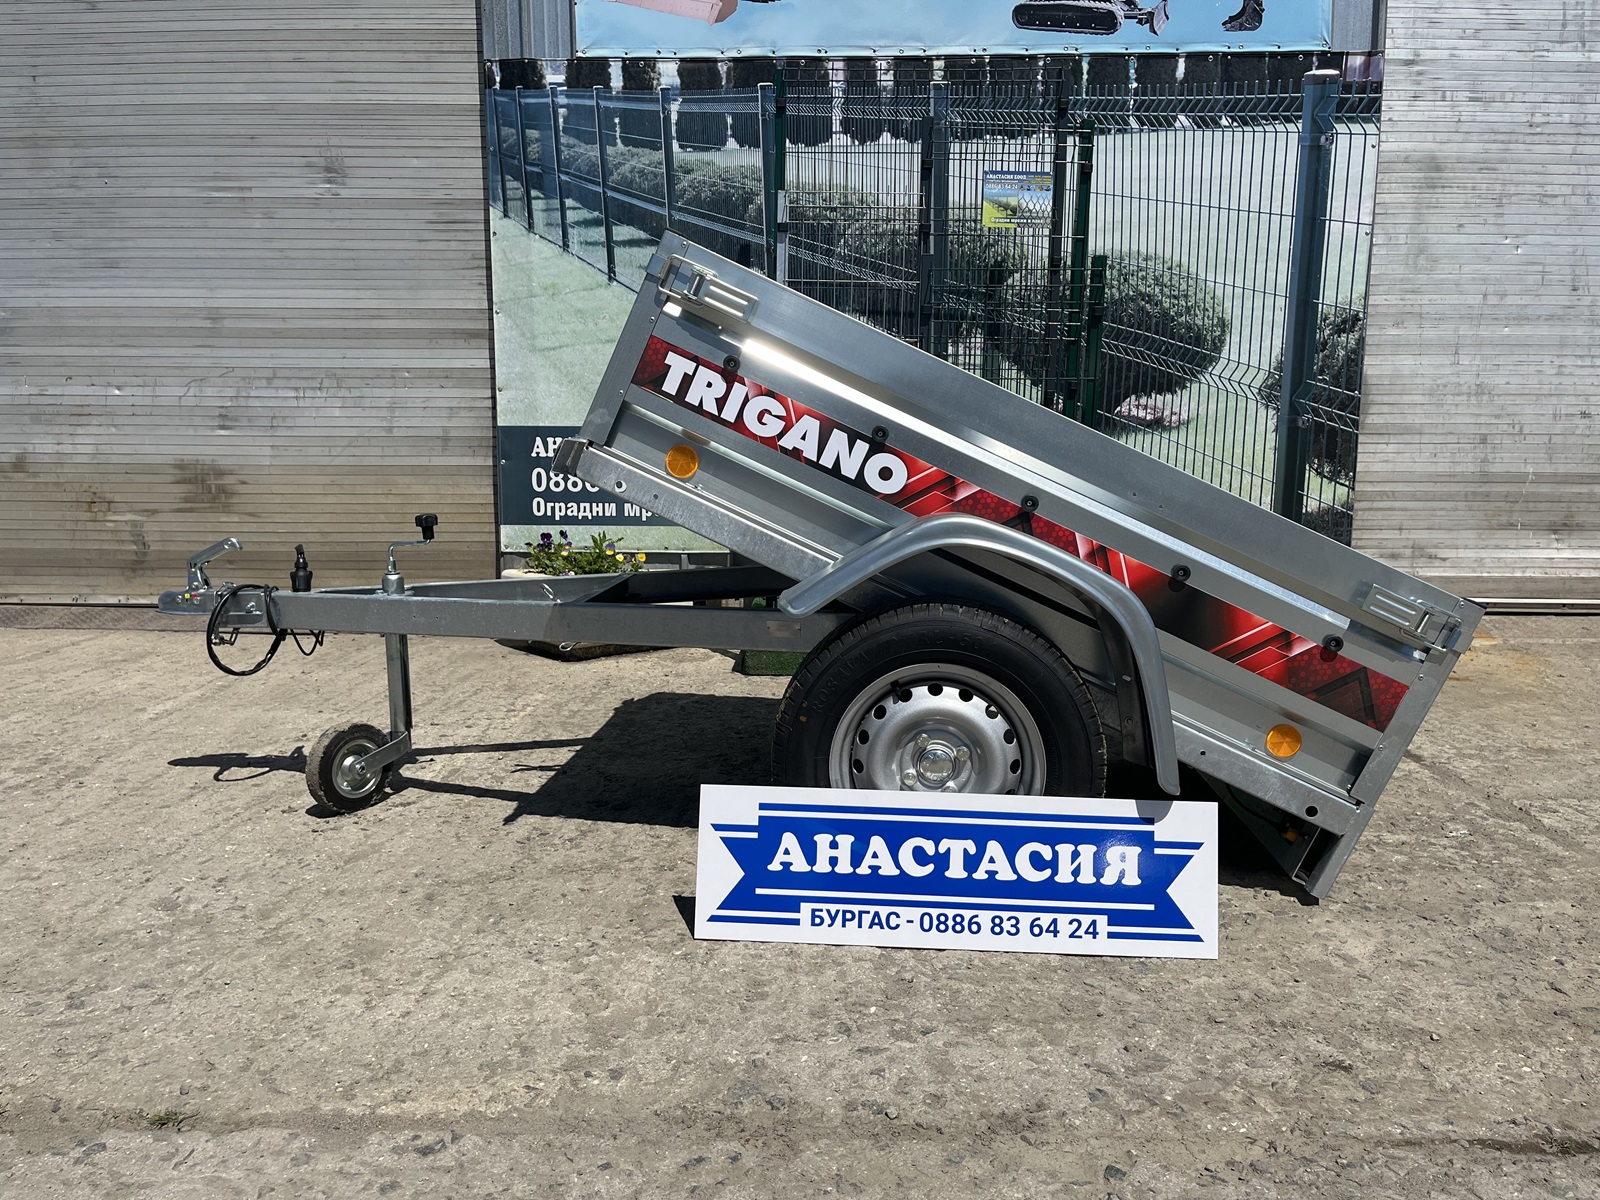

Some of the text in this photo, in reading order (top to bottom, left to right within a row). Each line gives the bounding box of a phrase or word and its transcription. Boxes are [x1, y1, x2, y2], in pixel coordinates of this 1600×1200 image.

[661, 350, 908, 494] TRIGANO
[532, 498, 617, 520] Оградни
[767, 831, 1142, 885] АНАСТАСИЯ
[810, 908, 901, 930] БУРГАС
[919, 912, 982, 935] 0886
[990, 914, 1021, 937] 83
[1029, 917, 1060, 938] 64
[1068, 918, 1099, 940] 24
